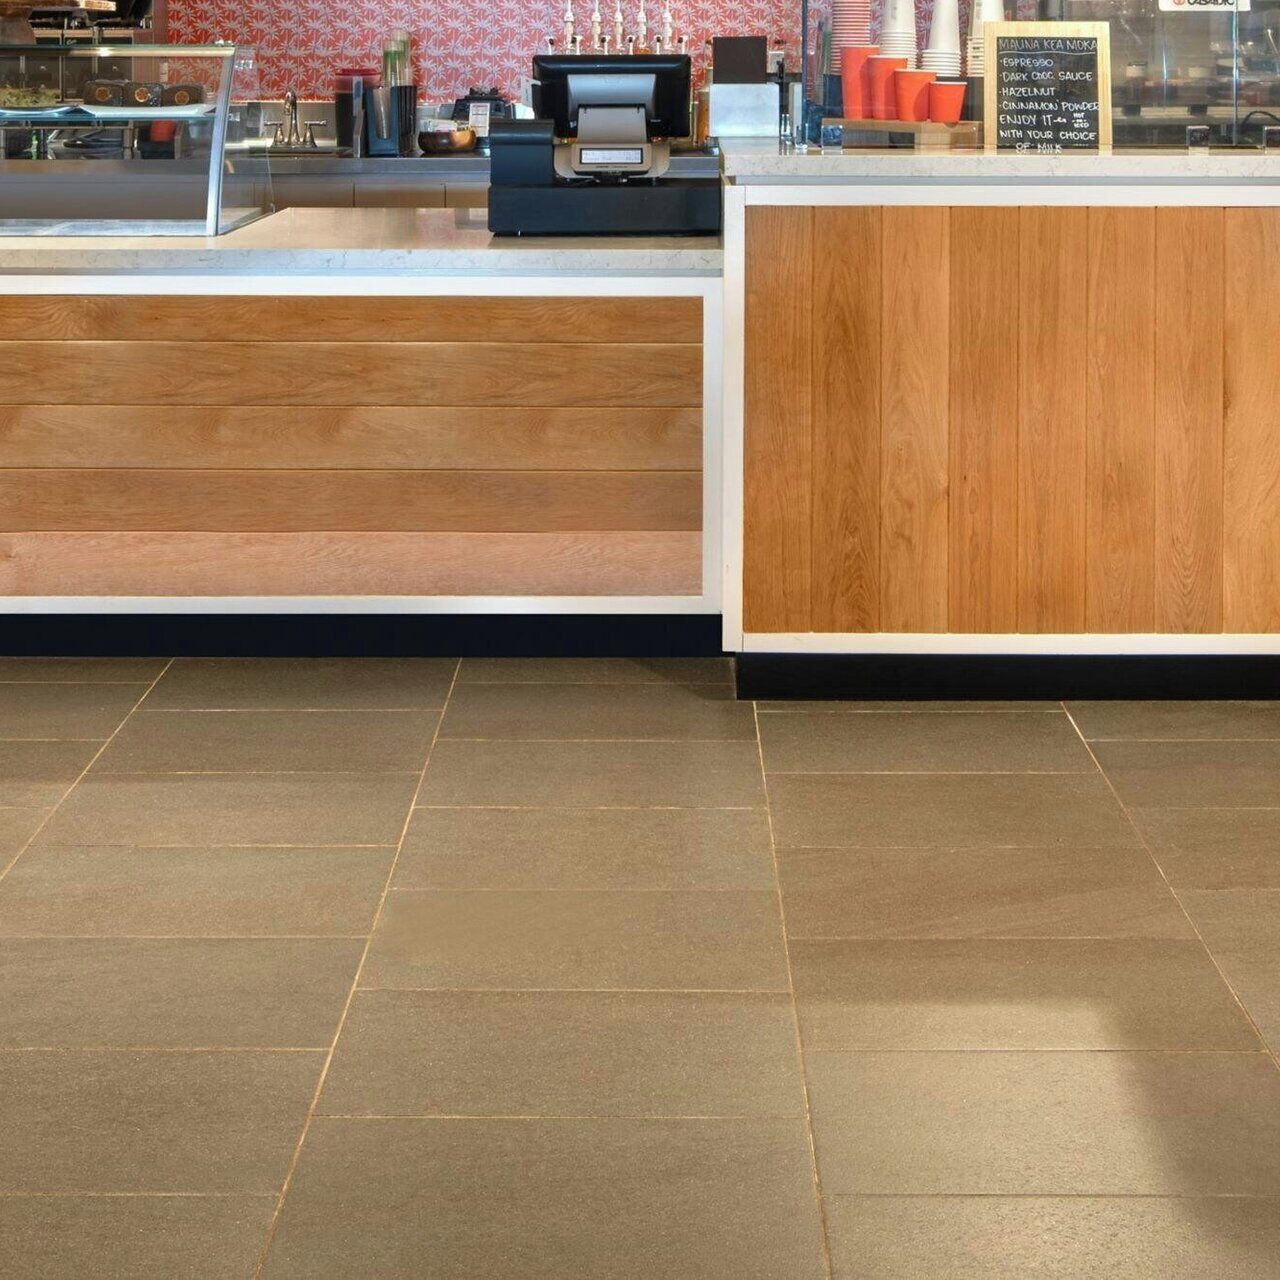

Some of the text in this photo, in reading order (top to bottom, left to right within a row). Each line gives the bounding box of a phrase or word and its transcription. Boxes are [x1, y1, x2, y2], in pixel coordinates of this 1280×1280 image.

[999, 39, 1040, 50] MAUNA
[1044, 39, 1063, 51] KEA
[1003, 58, 1053, 68] ESPRESSO
[1003, 72, 1028, 82] DARK
[1059, 72, 1093, 81] SAUCE
[1003, 87, 1055, 97] HAZELNUT
[999, 115, 1037, 125] ENJOY
[1000, 130, 1097, 140] WITH YOUR CHOICE
